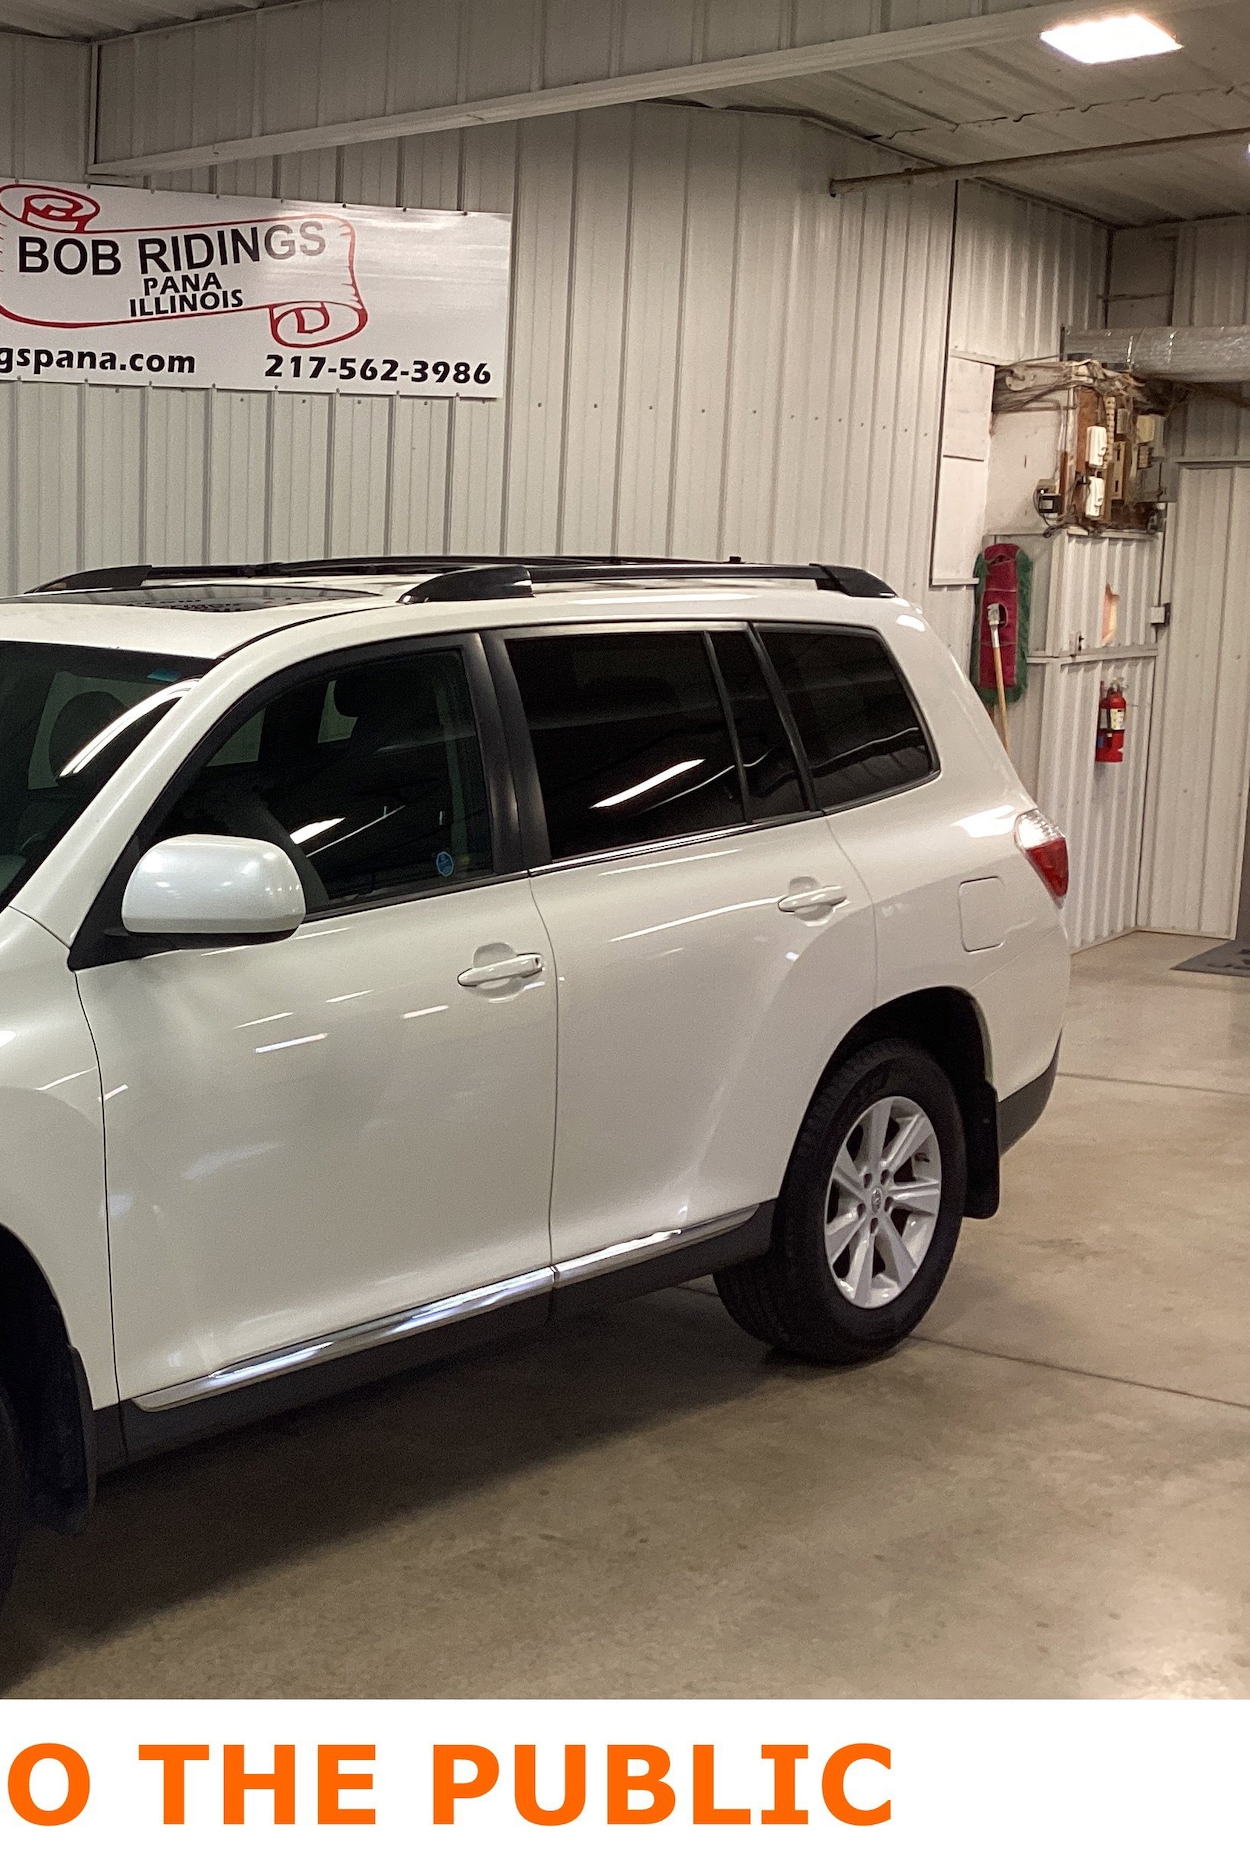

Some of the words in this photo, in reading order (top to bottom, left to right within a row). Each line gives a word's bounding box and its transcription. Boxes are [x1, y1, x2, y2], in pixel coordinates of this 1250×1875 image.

[18, 235, 122, 276] BOB
[138, 220, 327, 275] RIDINGS
[143, 271, 223, 297] PANA
[129, 289, 244, 318] ILLINOIS
[264, 353, 492, 385] 217-562-3986
